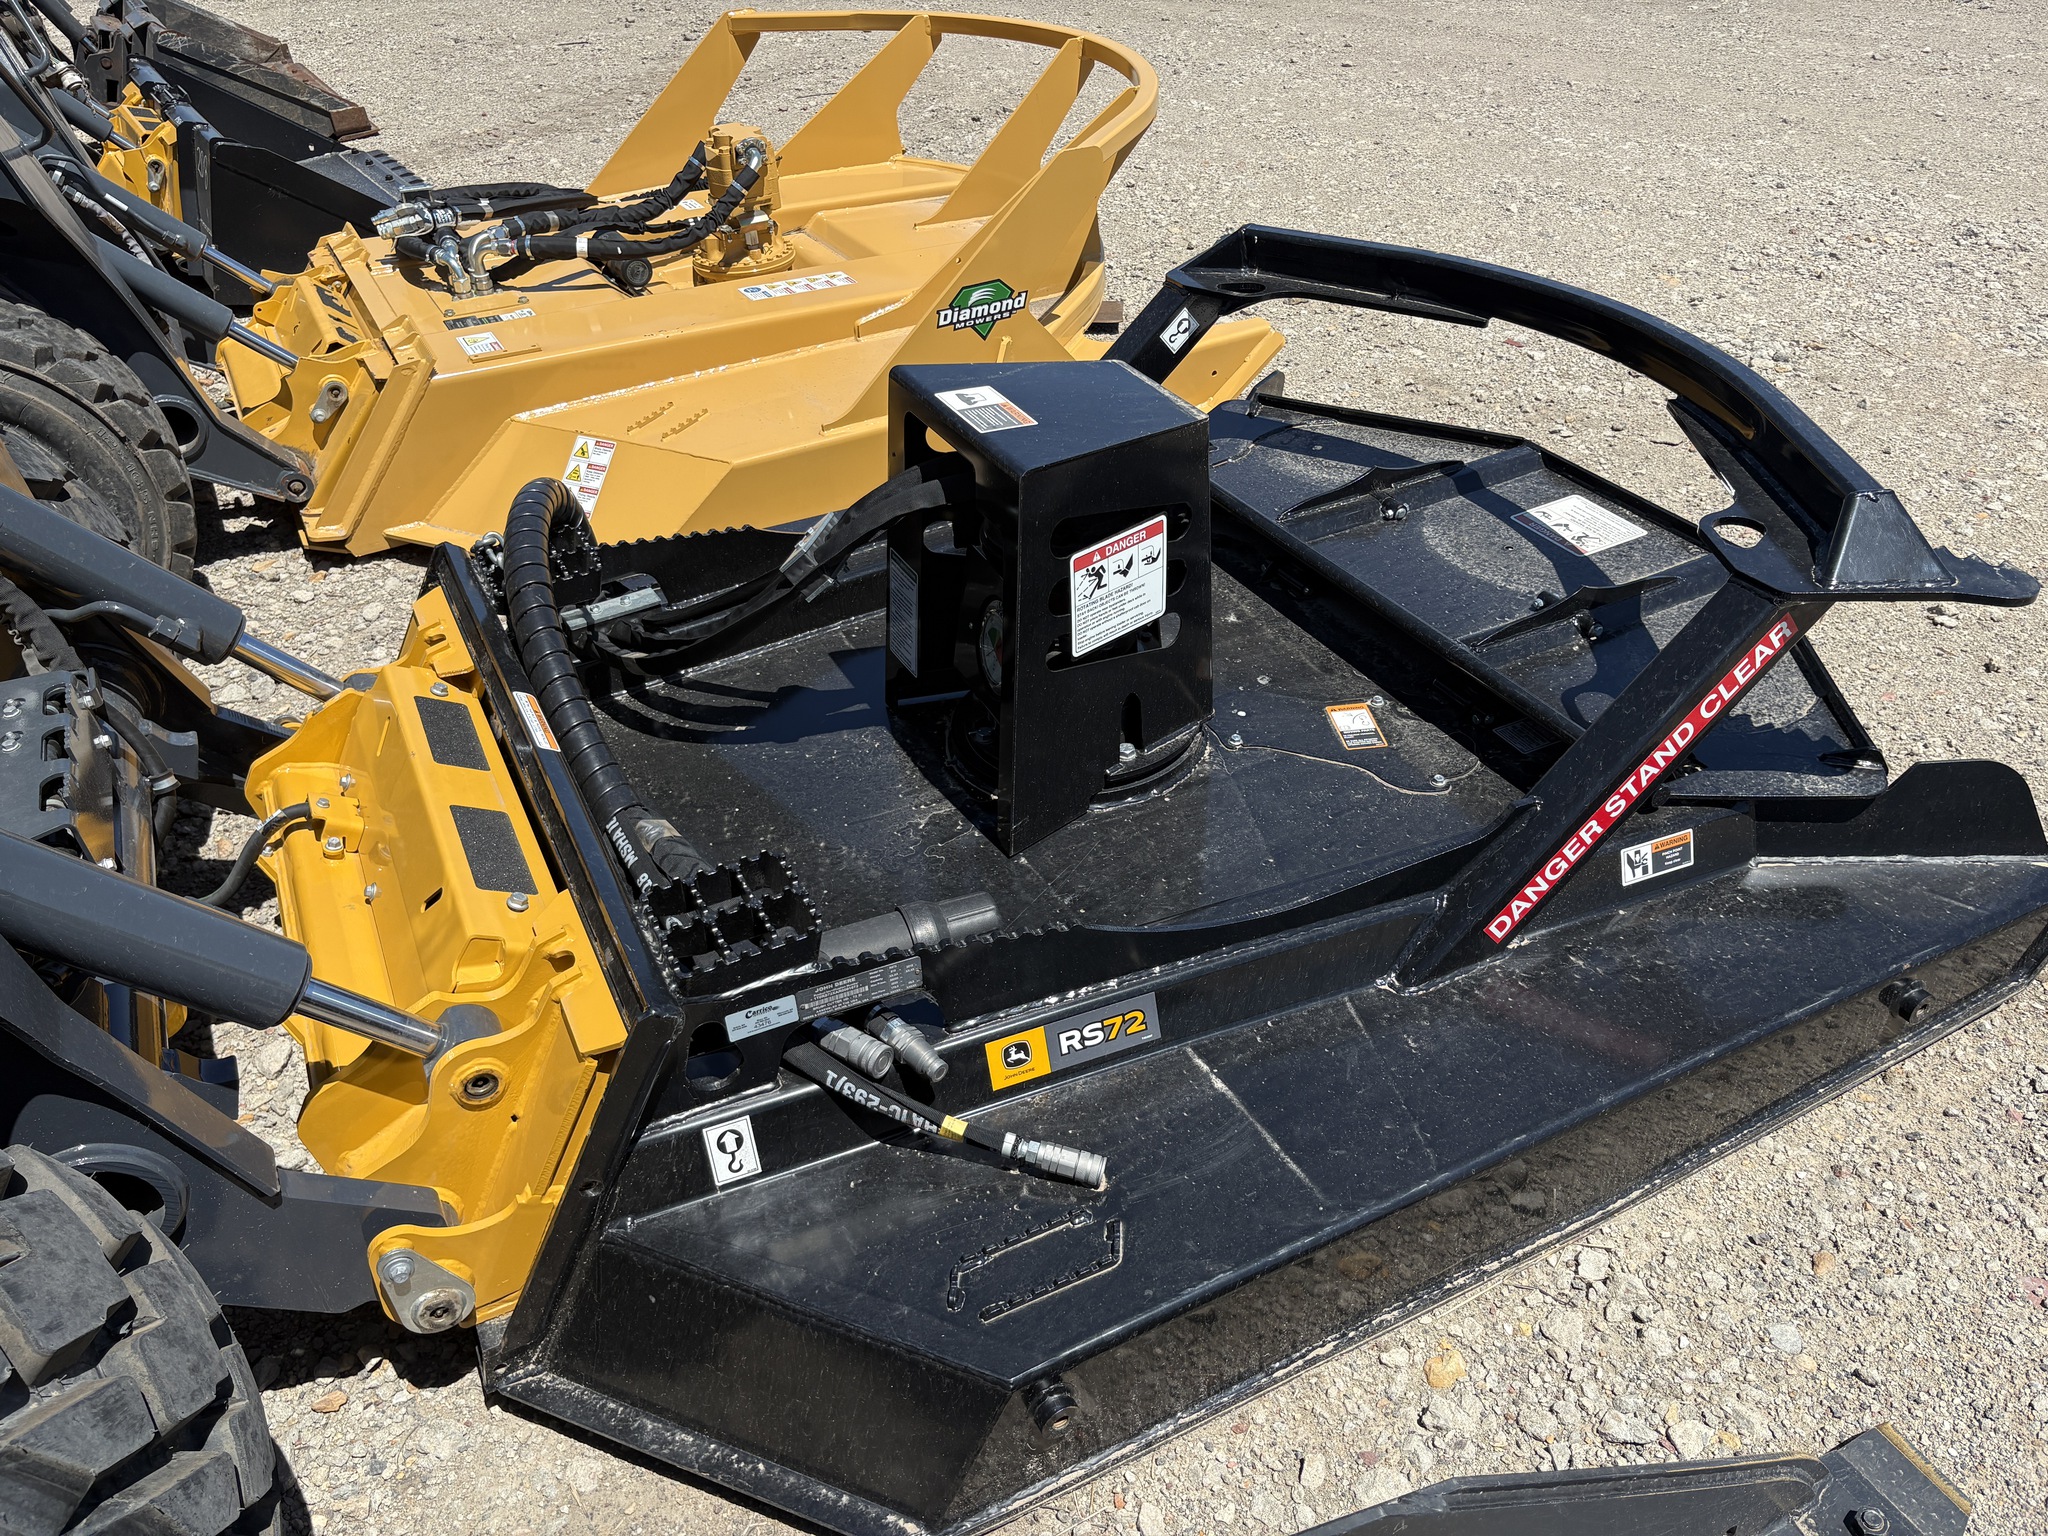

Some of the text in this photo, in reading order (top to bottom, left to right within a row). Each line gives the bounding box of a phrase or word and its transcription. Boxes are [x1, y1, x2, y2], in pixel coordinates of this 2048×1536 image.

[938, 292, 1027, 326] Diamond
[955, 310, 1010, 329] MOWERS
[1105, 530, 1147, 556] DANGER
[1530, 522, 1561, 541] DANGER
[1488, 818, 1604, 940] DANGER
[1605, 721, 1695, 819] STAND
[1699, 620, 1793, 719] CLEAR
[612, 826, 639, 869] MSHA
[1659, 834, 1689, 848] WARNING
[814, 983, 833, 993] JOHN
[834, 976, 856, 987] DEERE
[1058, 1009, 1147, 1056] RS72
[1004, 1067, 1036, 1081] JOHN DEERE
[826, 1069, 908, 1122] IC-293/1
